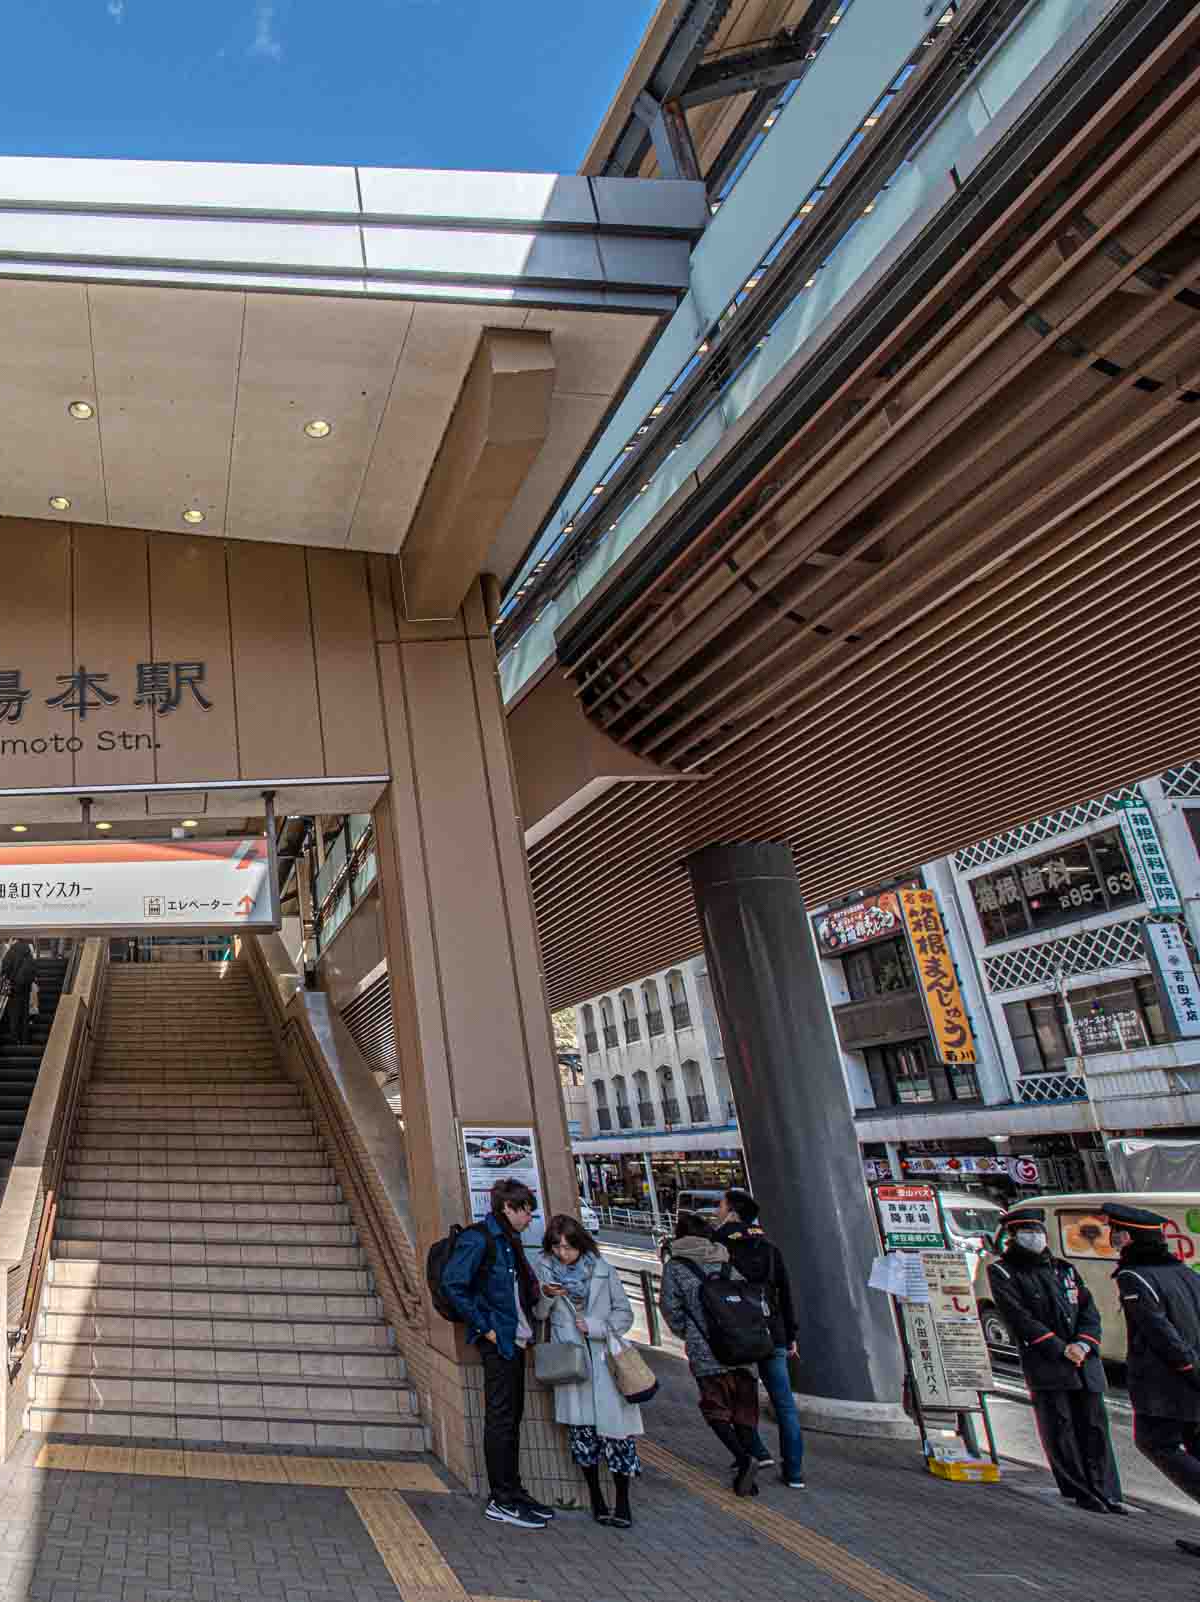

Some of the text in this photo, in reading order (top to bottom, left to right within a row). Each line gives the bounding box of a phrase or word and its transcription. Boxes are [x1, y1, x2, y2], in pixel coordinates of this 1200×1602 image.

[96, 730, 161, 752] Stn.
[975, 856, 1071, 913] 箱根歯科
[1131, 813, 1177, 901] 箱根歯科医院
[167, 900, 232, 912] エレベーター
[909, 906, 968, 1048] 箱根まんじゅう
